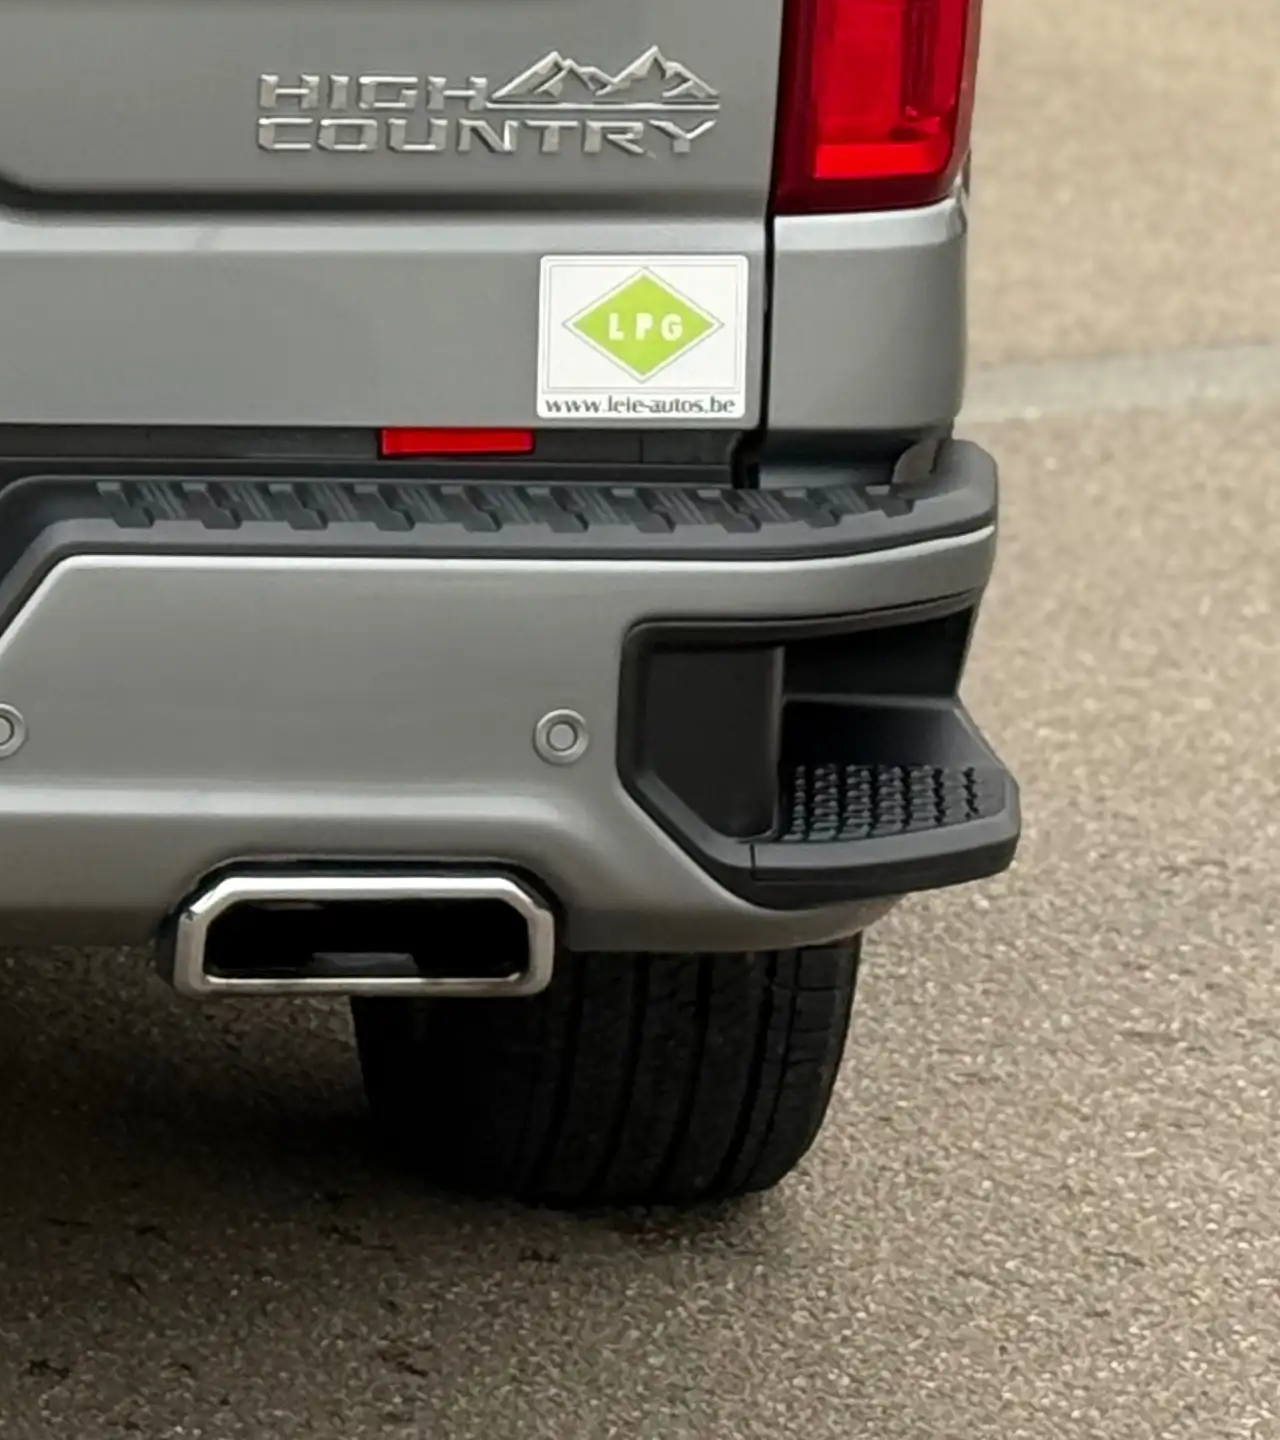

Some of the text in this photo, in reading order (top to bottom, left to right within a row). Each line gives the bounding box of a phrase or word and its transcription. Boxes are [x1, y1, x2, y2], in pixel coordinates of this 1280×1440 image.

[258, 73, 488, 111] HIGH
[257, 117, 717, 157] COUNTRY
[545, 395, 736, 414] www.leie-autos.be
